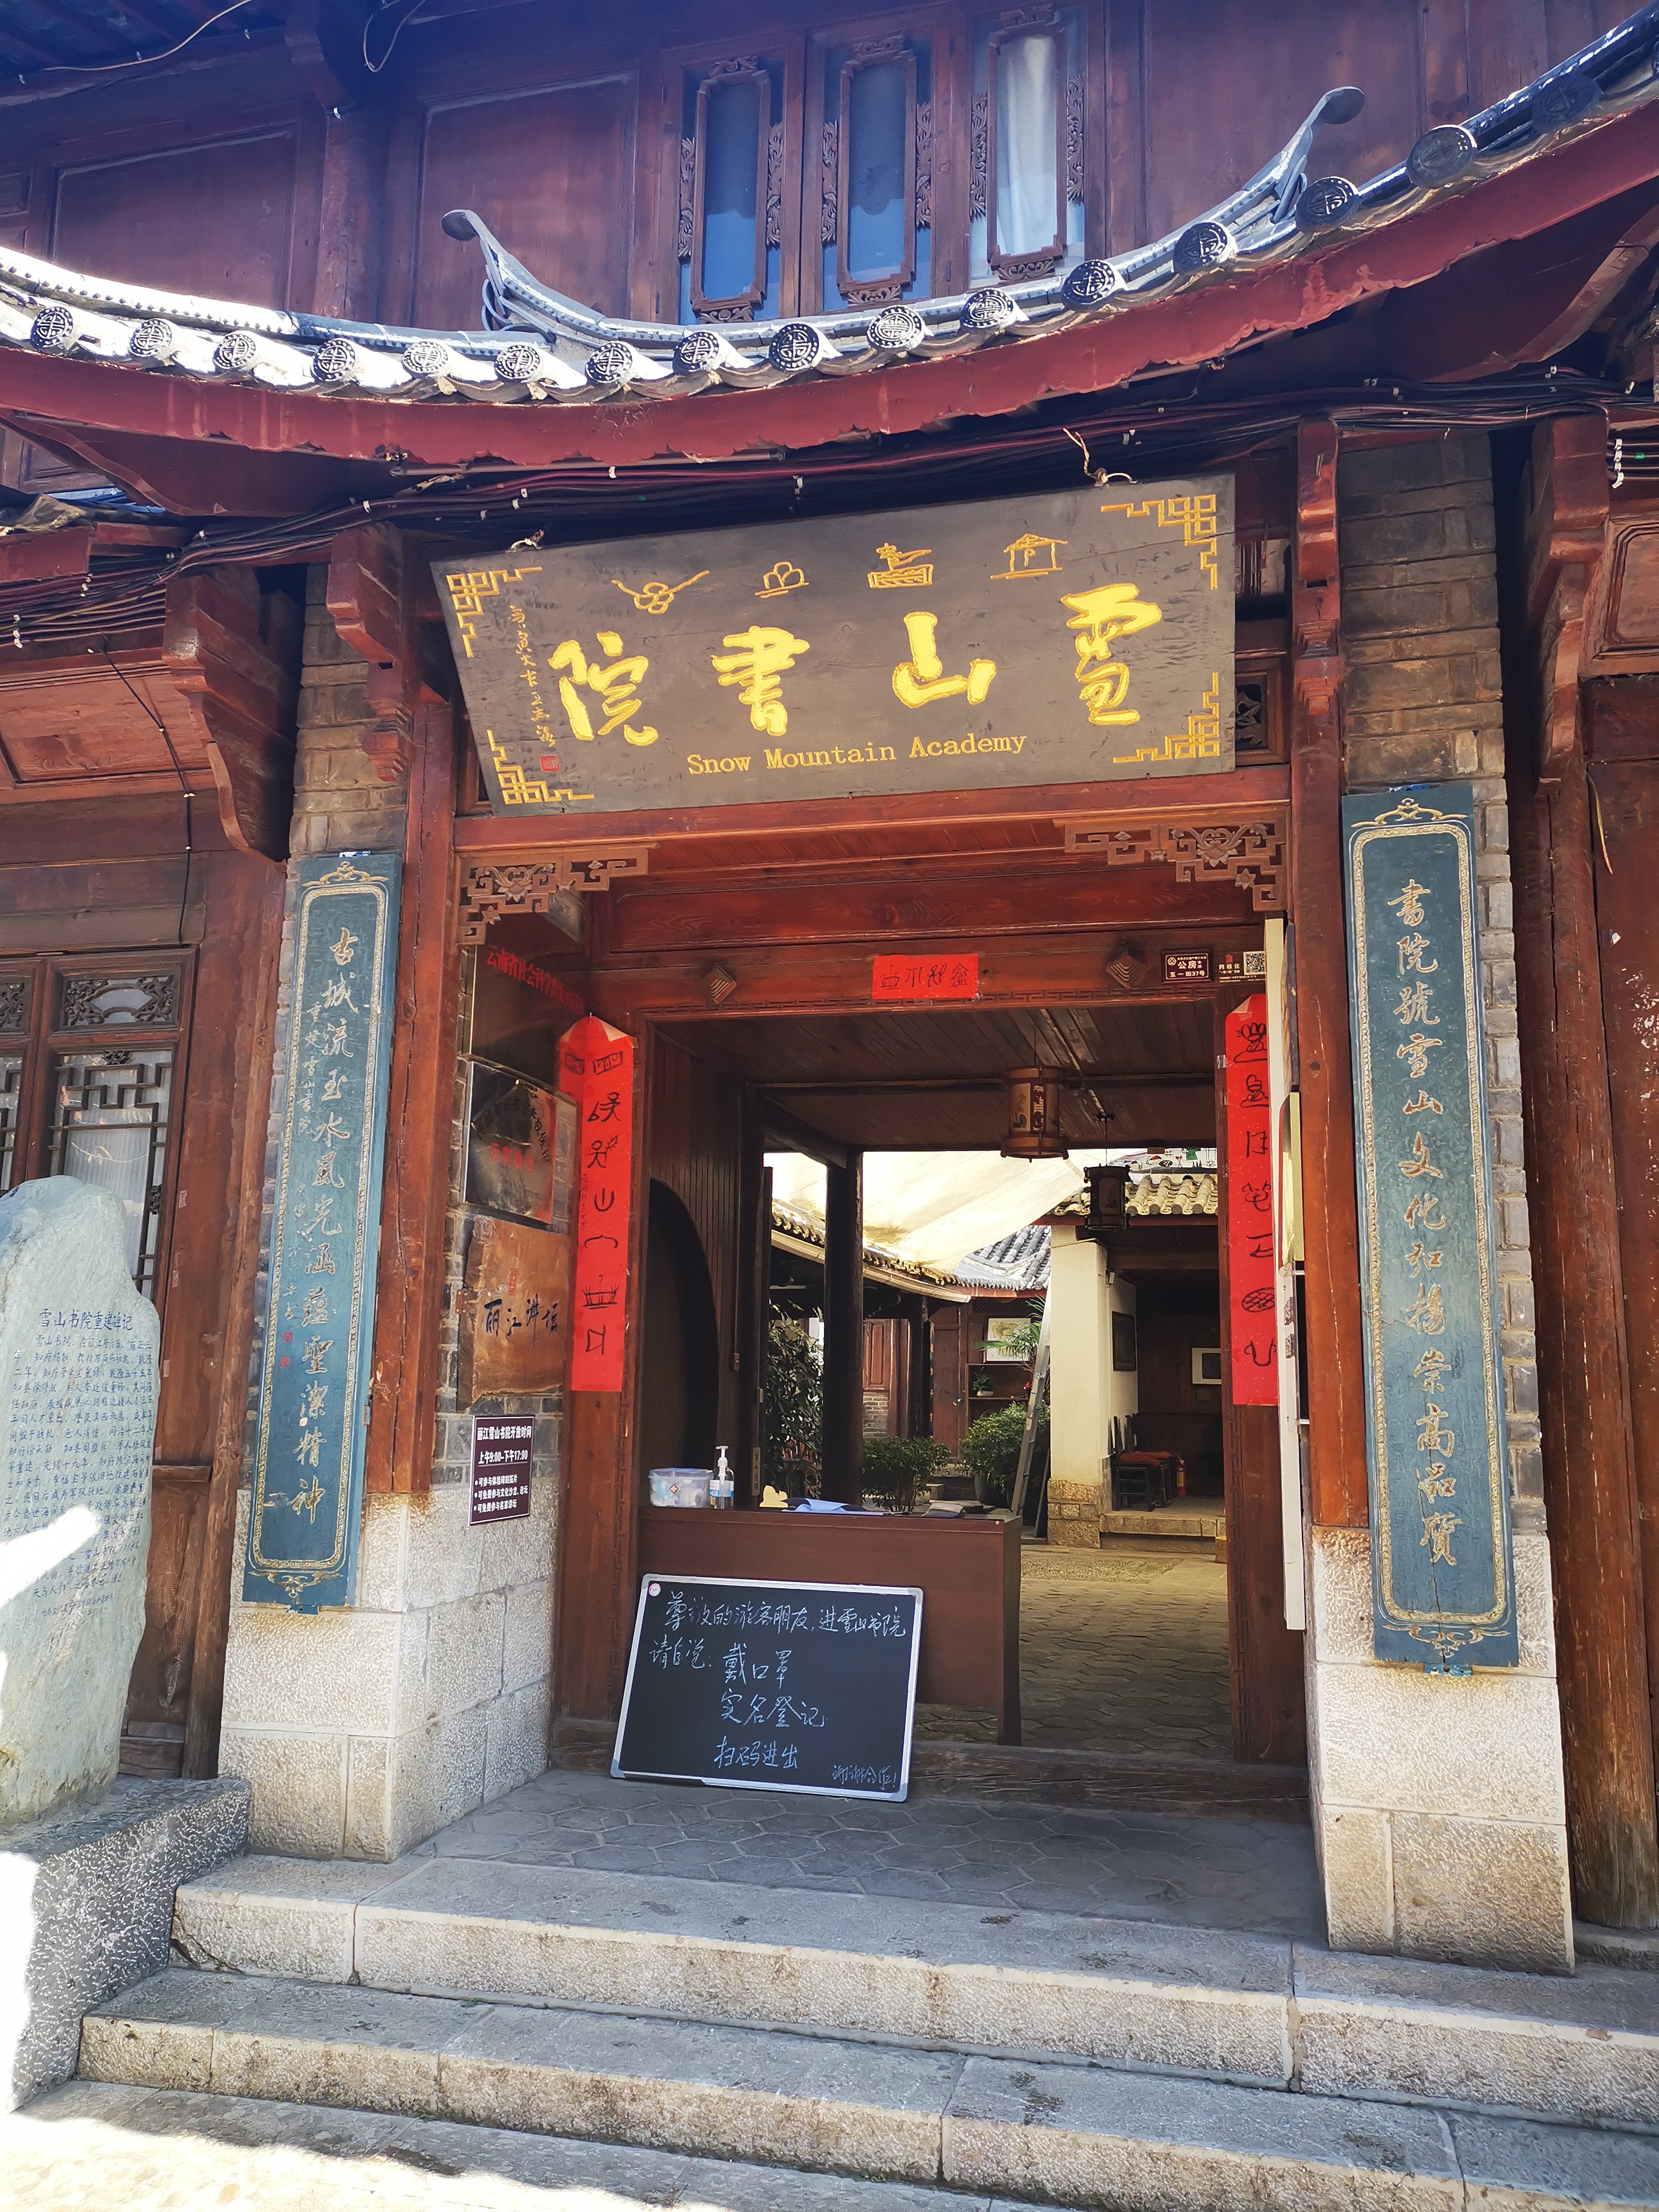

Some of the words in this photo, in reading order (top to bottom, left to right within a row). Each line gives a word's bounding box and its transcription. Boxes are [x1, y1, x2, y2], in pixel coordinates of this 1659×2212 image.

[687, 754, 751, 775] Snow
[763, 744, 897, 770] Mountain
[909, 732, 1027, 759] Academy
[38, 1308, 133, 1332] 雪山书院重建碑记
[477, 1425, 532, 1440] 丽江雪山书院开放时间
[722, 1642, 792, 1690] 戴口罩
[721, 1688, 828, 1728] 实名登记
[714, 1736, 798, 1770] 扫码进出
